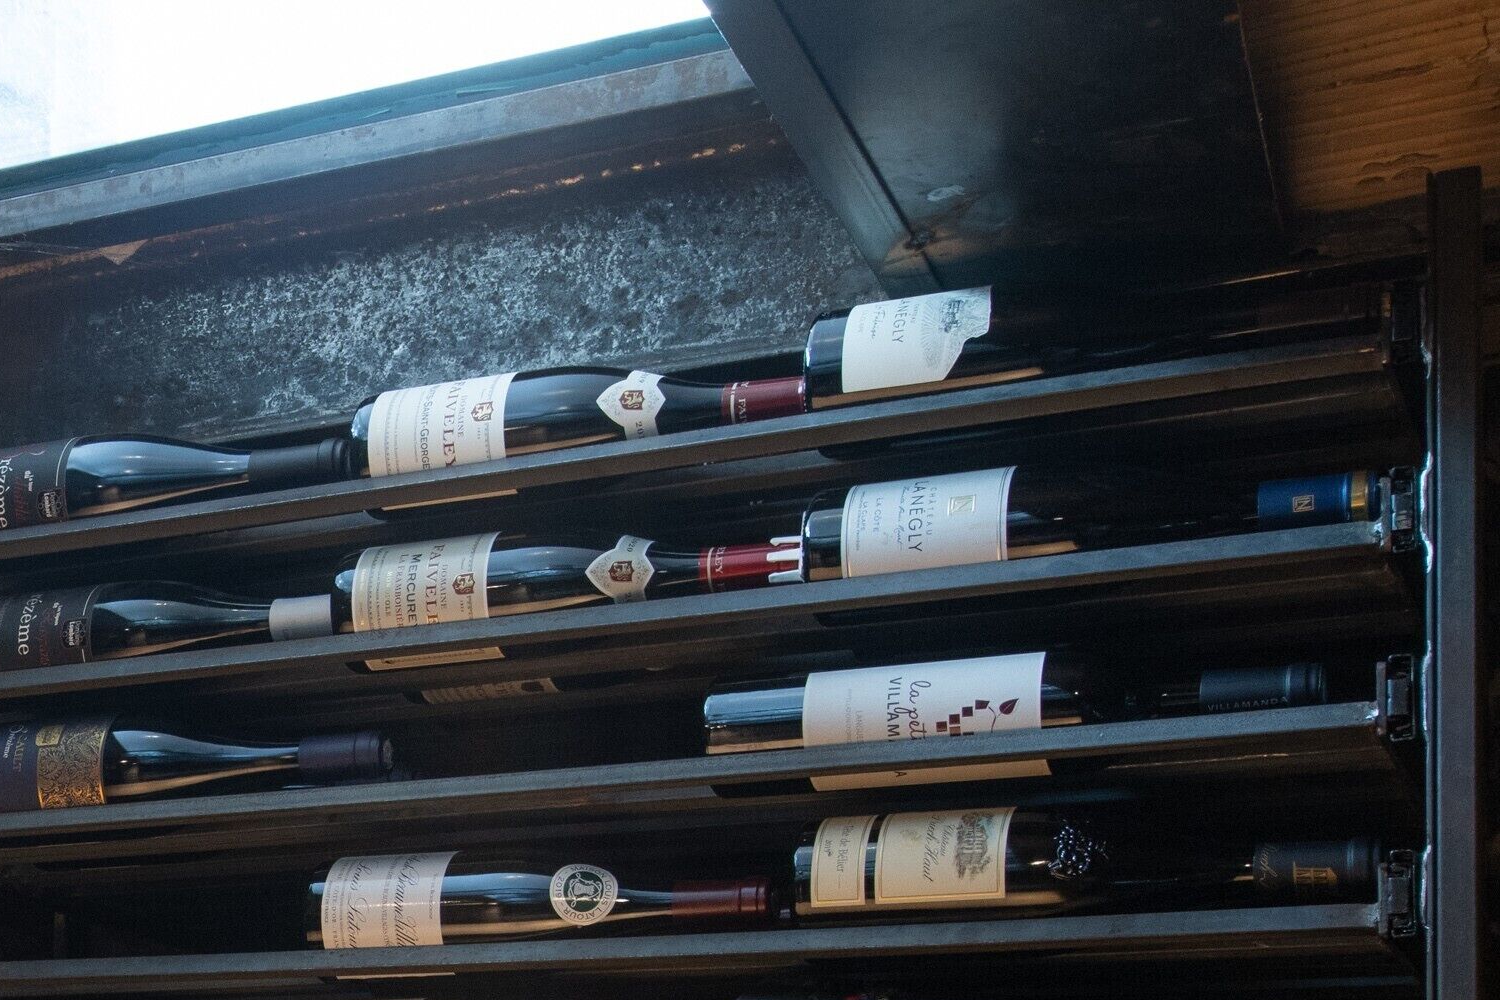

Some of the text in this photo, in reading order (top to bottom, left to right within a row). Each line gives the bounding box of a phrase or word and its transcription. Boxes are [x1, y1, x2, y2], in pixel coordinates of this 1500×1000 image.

[419, 384, 438, 470] UITS-SAINT-GEORGE
[456, 394, 467, 438] DOMAINE
[908, 495, 926, 552] NÉGLY
[926, 486, 938, 536] CHÂTEAU
[406, 553, 423, 628] MERCURE
[424, 544, 445, 625] FAIVELE
[439, 564, 449, 609] DOMAINE
[17, 593, 44, 656] rézème
[896, 706, 928, 740] pet
[600, 878, 615, 909] LOUIS
